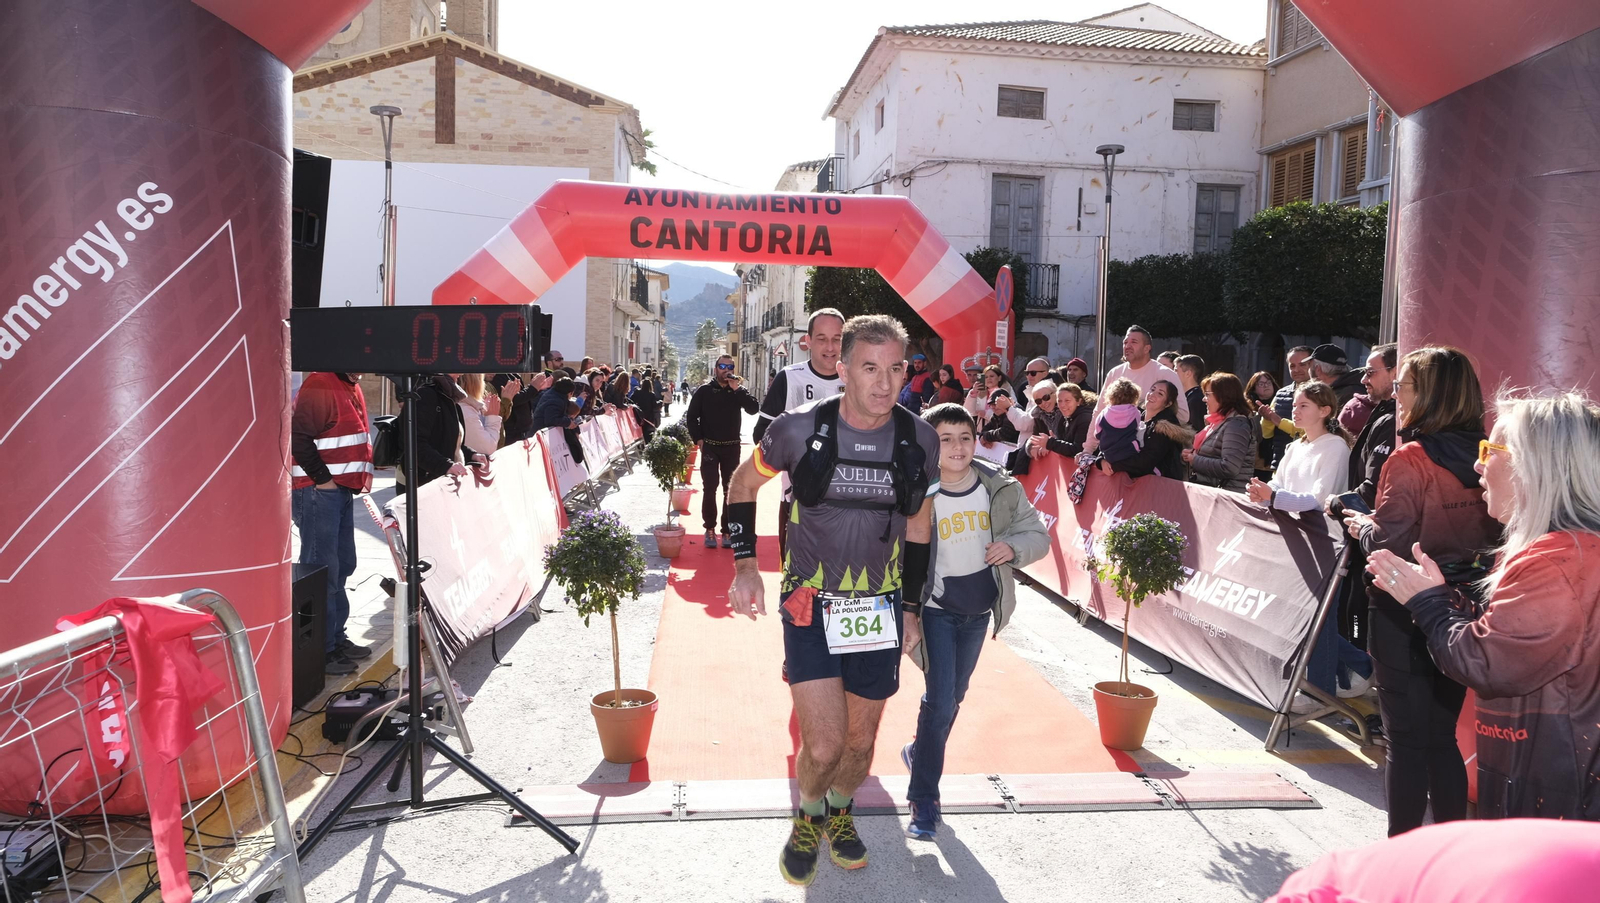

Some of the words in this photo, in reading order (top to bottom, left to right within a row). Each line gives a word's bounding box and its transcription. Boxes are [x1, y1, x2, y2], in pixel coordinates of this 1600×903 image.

[624, 188, 842, 216] AYUNTAMIENTO
[629, 215, 833, 257] CANTORIA
[0, 181, 174, 370] amergy.es
[805, 384, 814, 400] 6
[831, 467, 894, 484] UELLA
[836, 486, 868, 494] STONE
[873, 487, 894, 496] 1958
[1173, 566, 1278, 620] EAMERGY
[839, 614, 883, 638] 364
